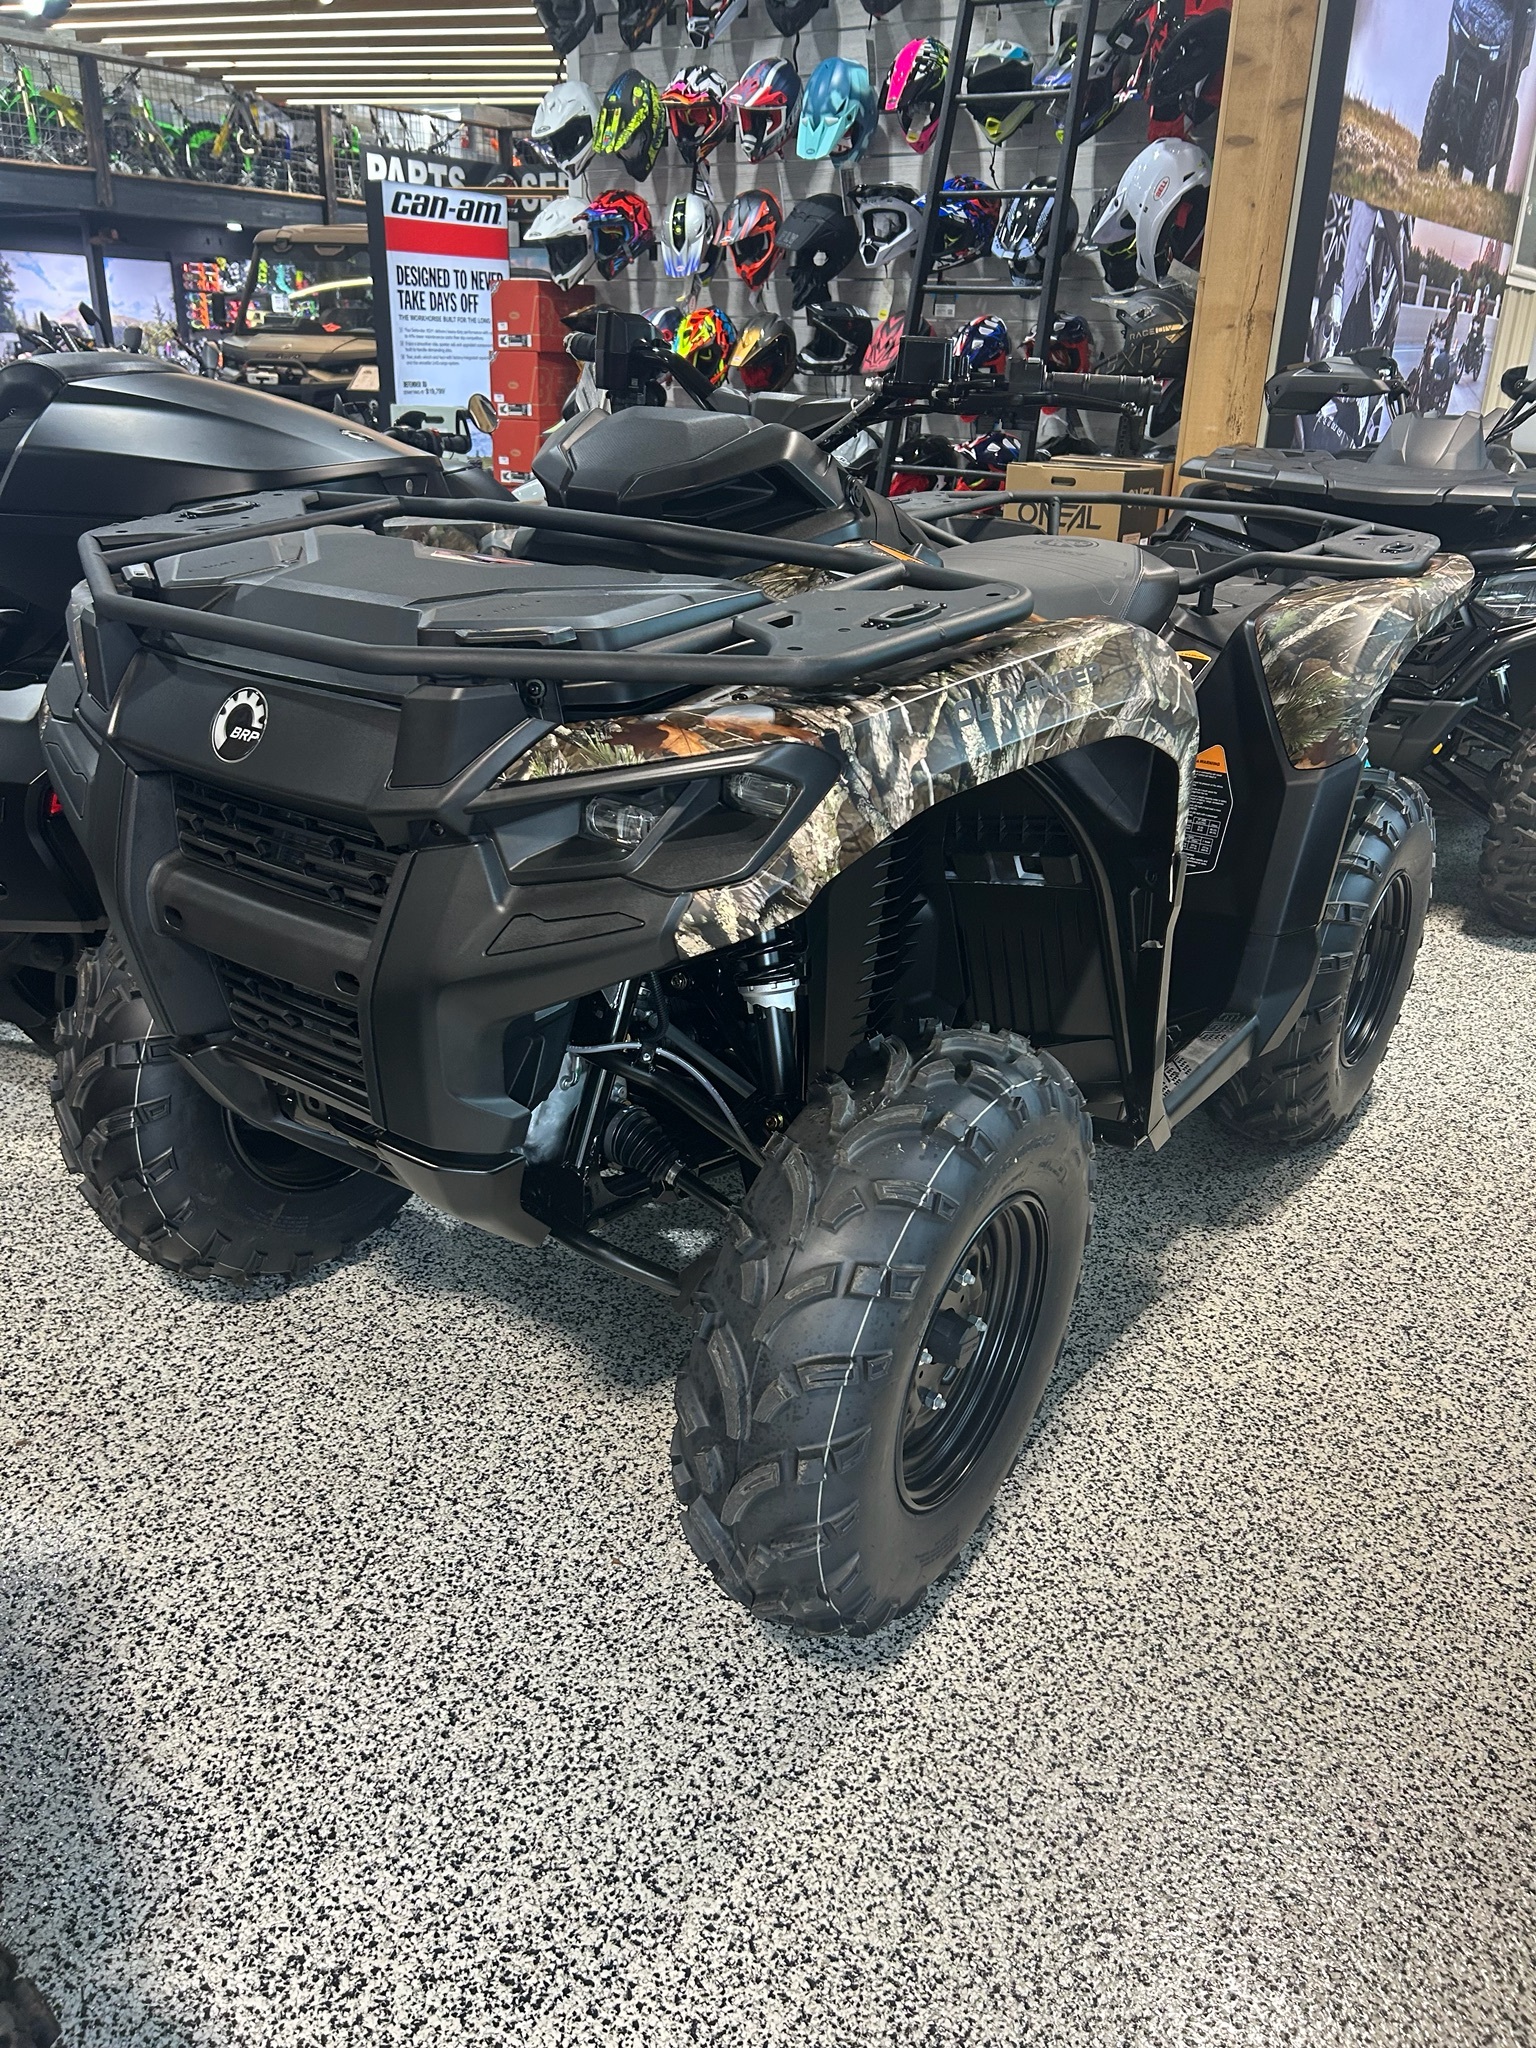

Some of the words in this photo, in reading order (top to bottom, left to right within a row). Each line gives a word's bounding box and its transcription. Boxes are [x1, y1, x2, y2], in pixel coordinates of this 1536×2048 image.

[391, 190, 502, 226] can-am
[396, 264, 451, 289] DESIGNED
[453, 269, 467, 290] TO
[397, 289, 426, 311] TAKE
[429, 291, 457, 312] DAYS
[460, 293, 479, 314] OFF
[954, 662, 1101, 728] OUTLANDER
[229, 726, 260, 742] BRP
